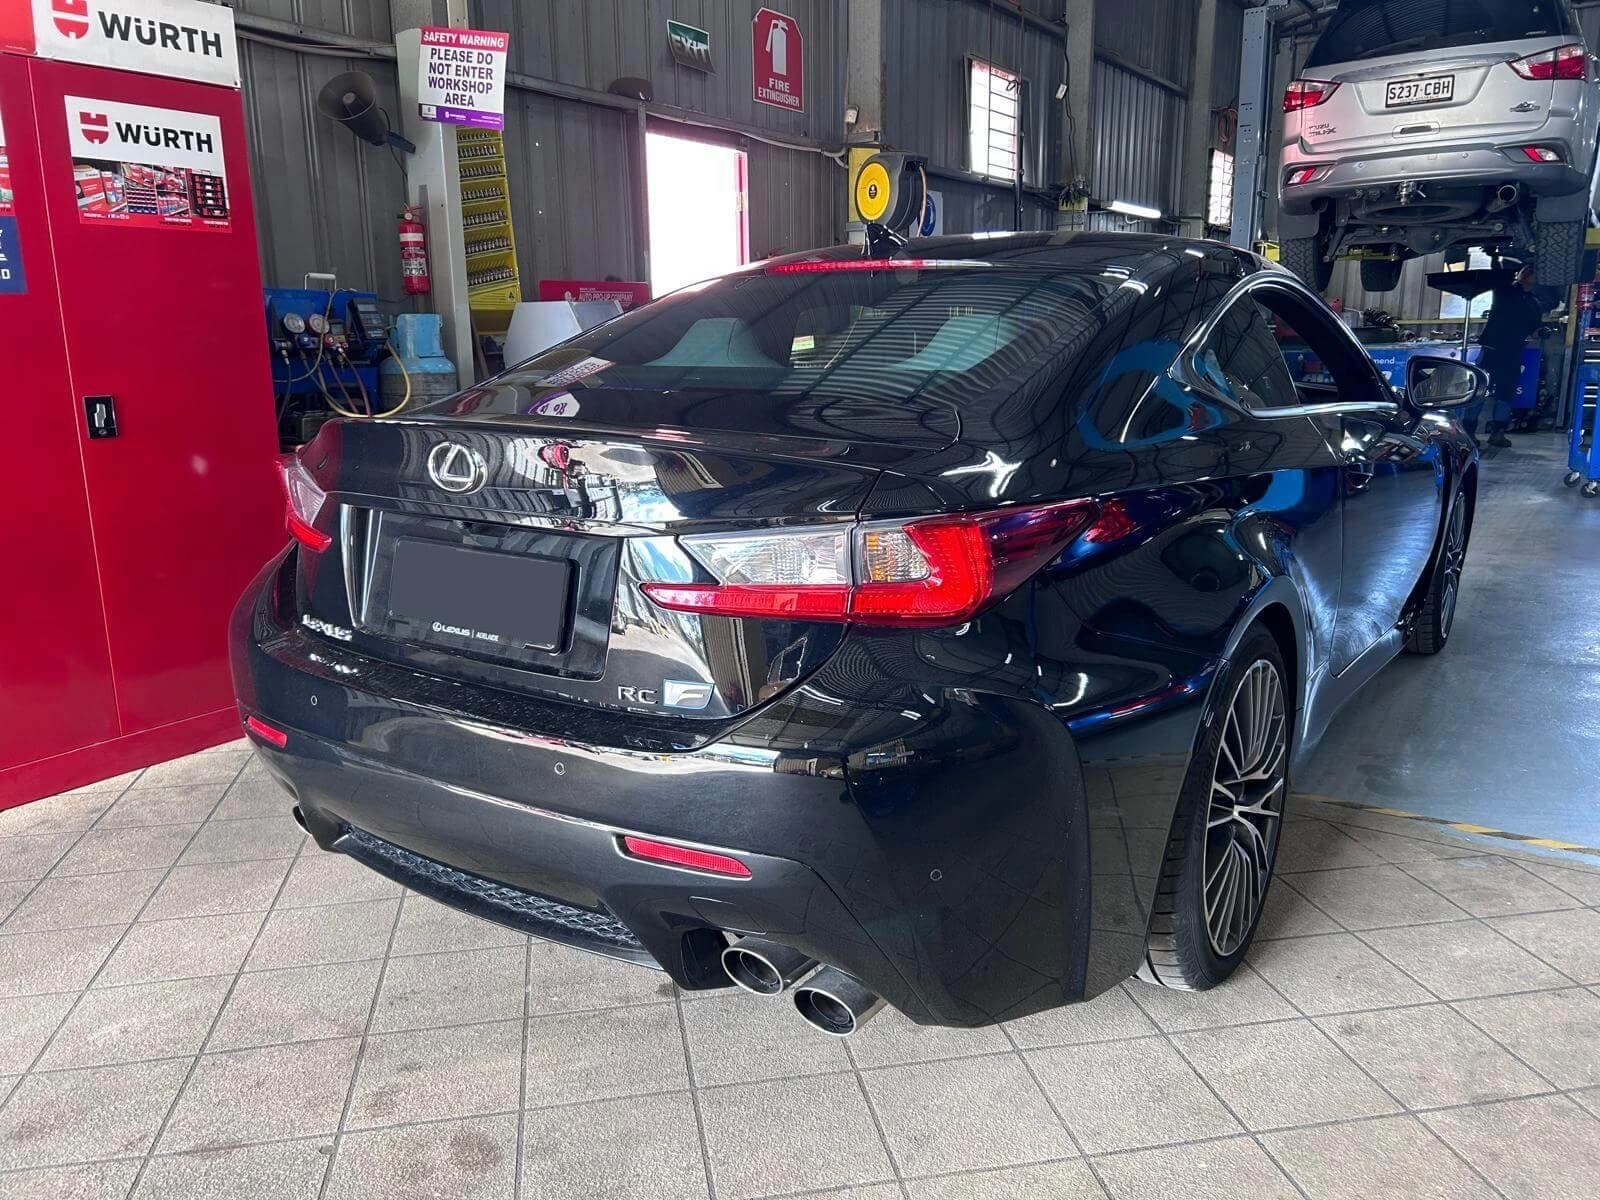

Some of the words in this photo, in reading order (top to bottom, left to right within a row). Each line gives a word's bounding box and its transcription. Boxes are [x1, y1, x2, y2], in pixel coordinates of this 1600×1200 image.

[98, 11, 222, 58] WÜRTH
[423, 31, 457, 44] SAFETY
[459, 35, 504, 48] WARNING
[430, 48, 473, 63] PLEASE
[476, 52, 493, 65] DO
[671, 34, 710, 64] EXIT
[429, 62, 451, 75] NOT
[455, 65, 493, 80] ENTER
[428, 76, 493, 94] WORKSHOP
[768, 78, 790, 93] FIRE
[444, 93, 475, 107] AREA
[758, 86, 800, 107] EXTINGUISHER
[116, 121, 213, 154] WÜRTH
[579, 293, 592, 302] AUTO
[442, 624, 470, 636] LEXUS
[476, 632, 499, 642] ADELAIDE
[617, 685, 658, 705] RC
